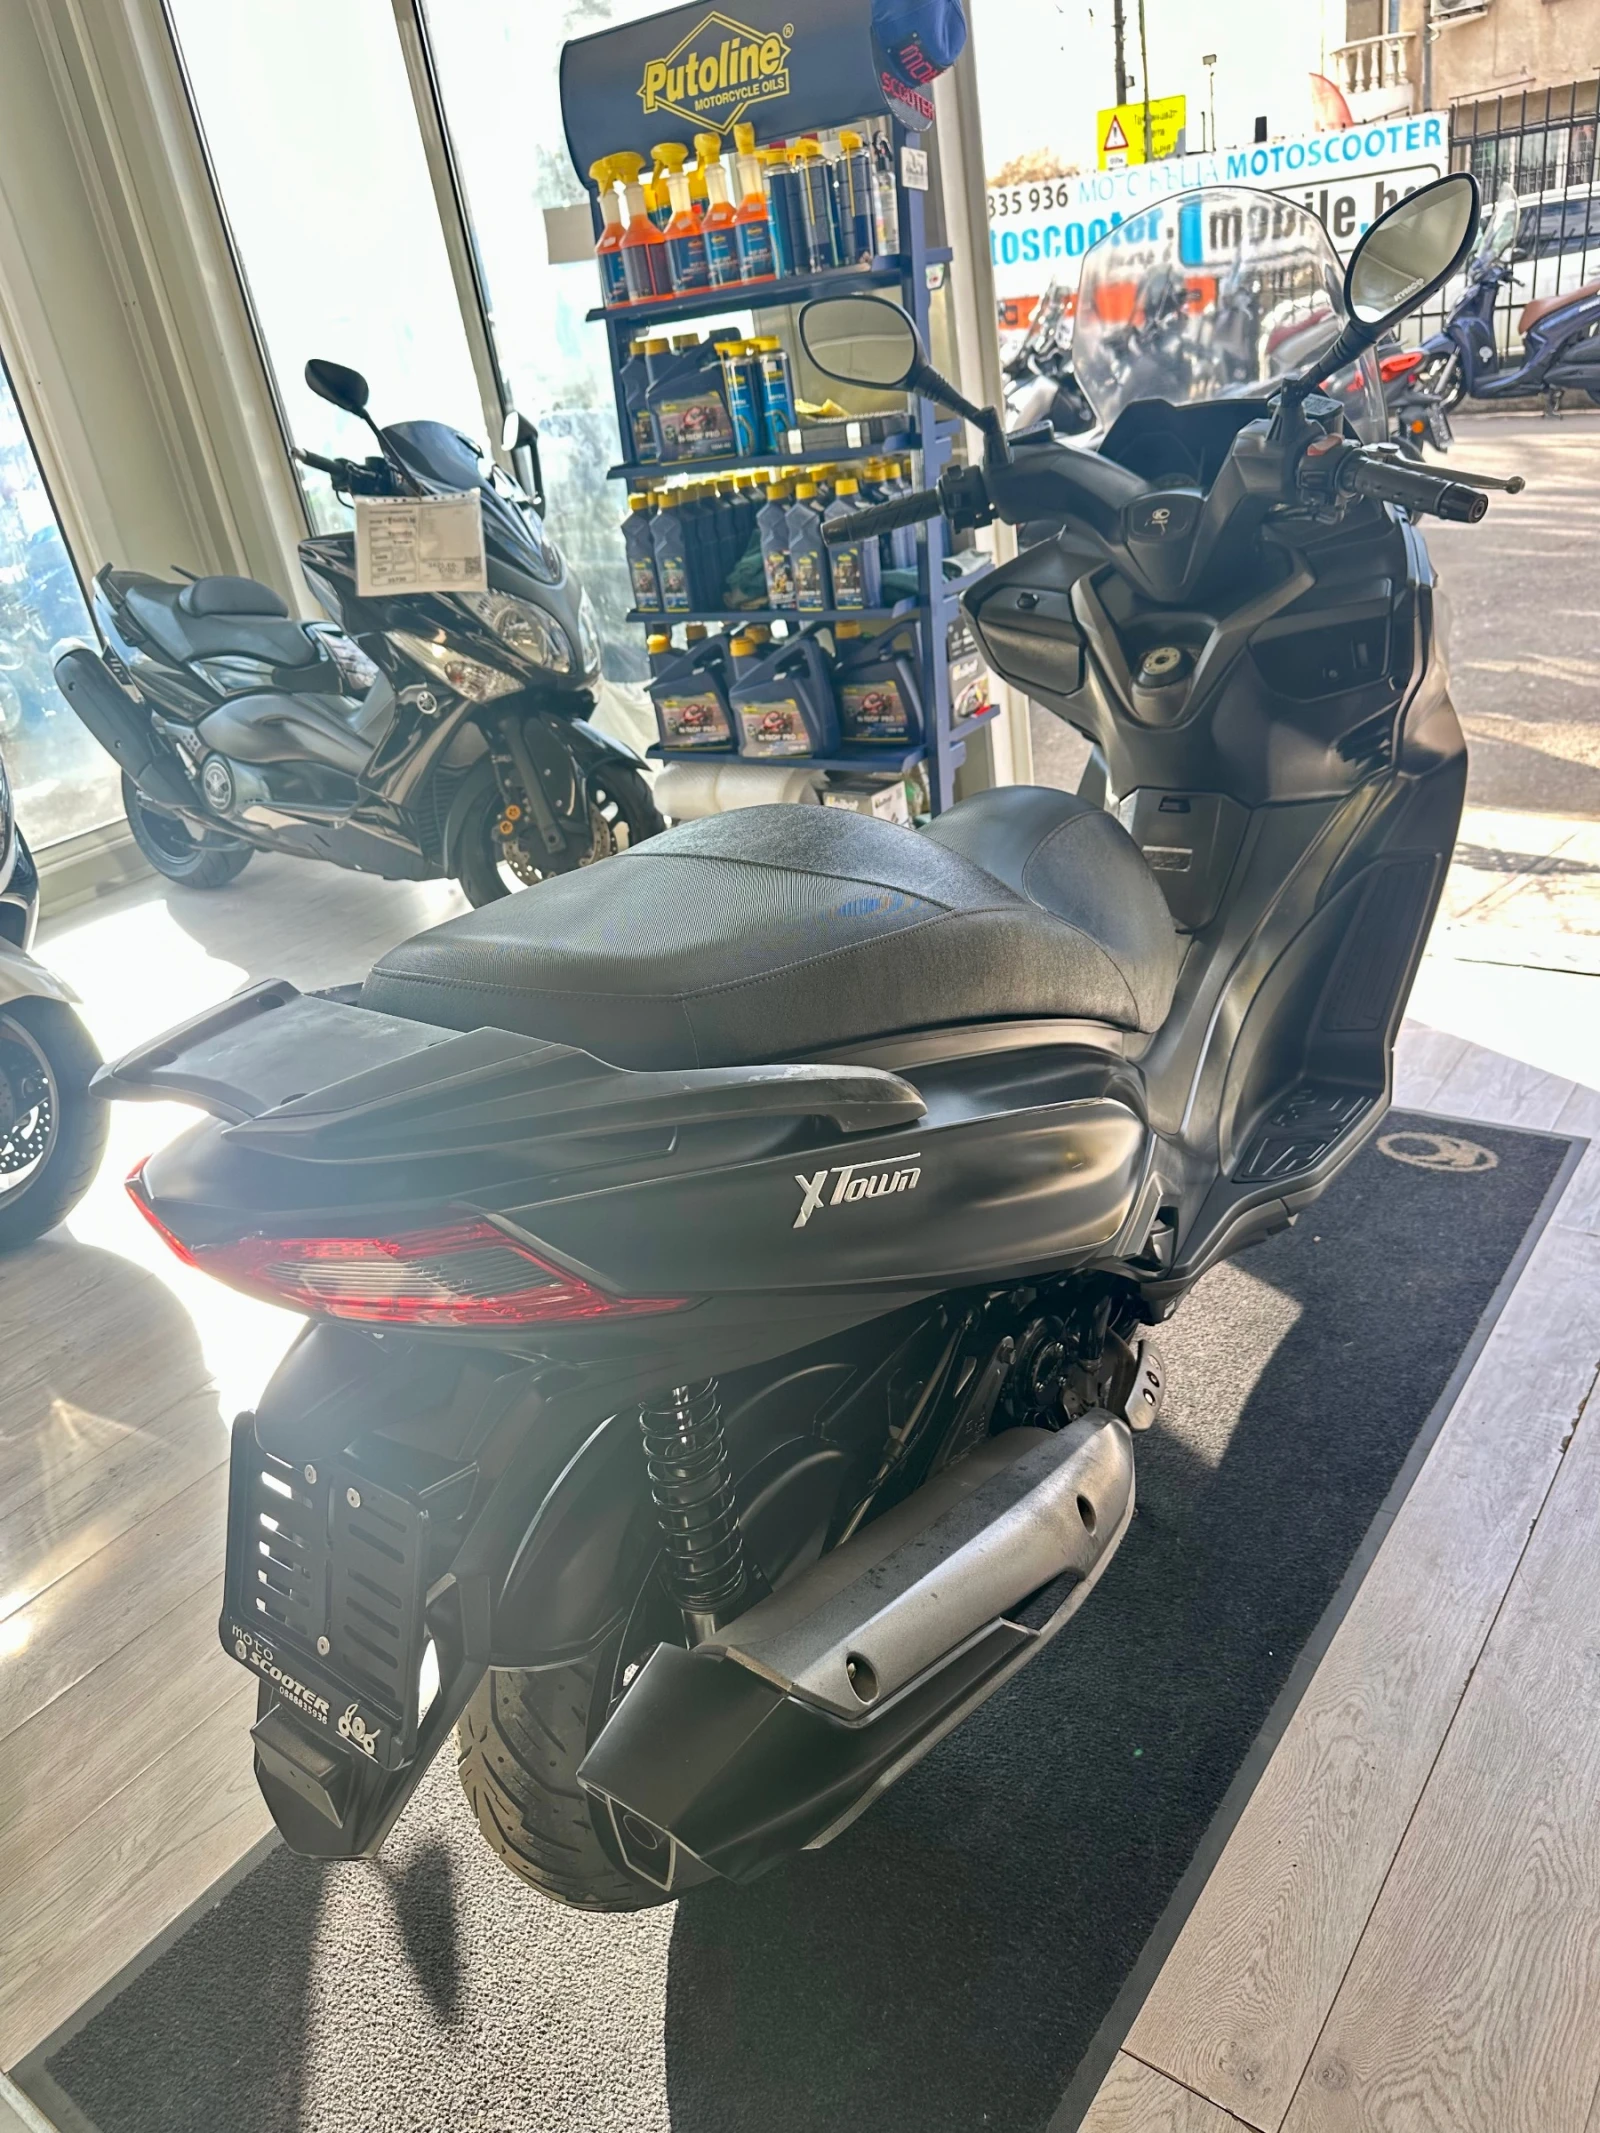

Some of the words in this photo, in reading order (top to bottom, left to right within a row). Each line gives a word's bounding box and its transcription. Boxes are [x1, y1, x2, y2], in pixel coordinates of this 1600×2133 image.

[645, 37, 781, 109] Putoline
[695, 83, 760, 112] MOTORCYCLE
[761, 76, 785, 94] OILS
[1227, 119, 1441, 180] MOTOSCOOTER
[1028, 183, 1069, 212] 936
[231, 1624, 274, 1661] moto
[249, 1651, 330, 1716] SCOOTER
